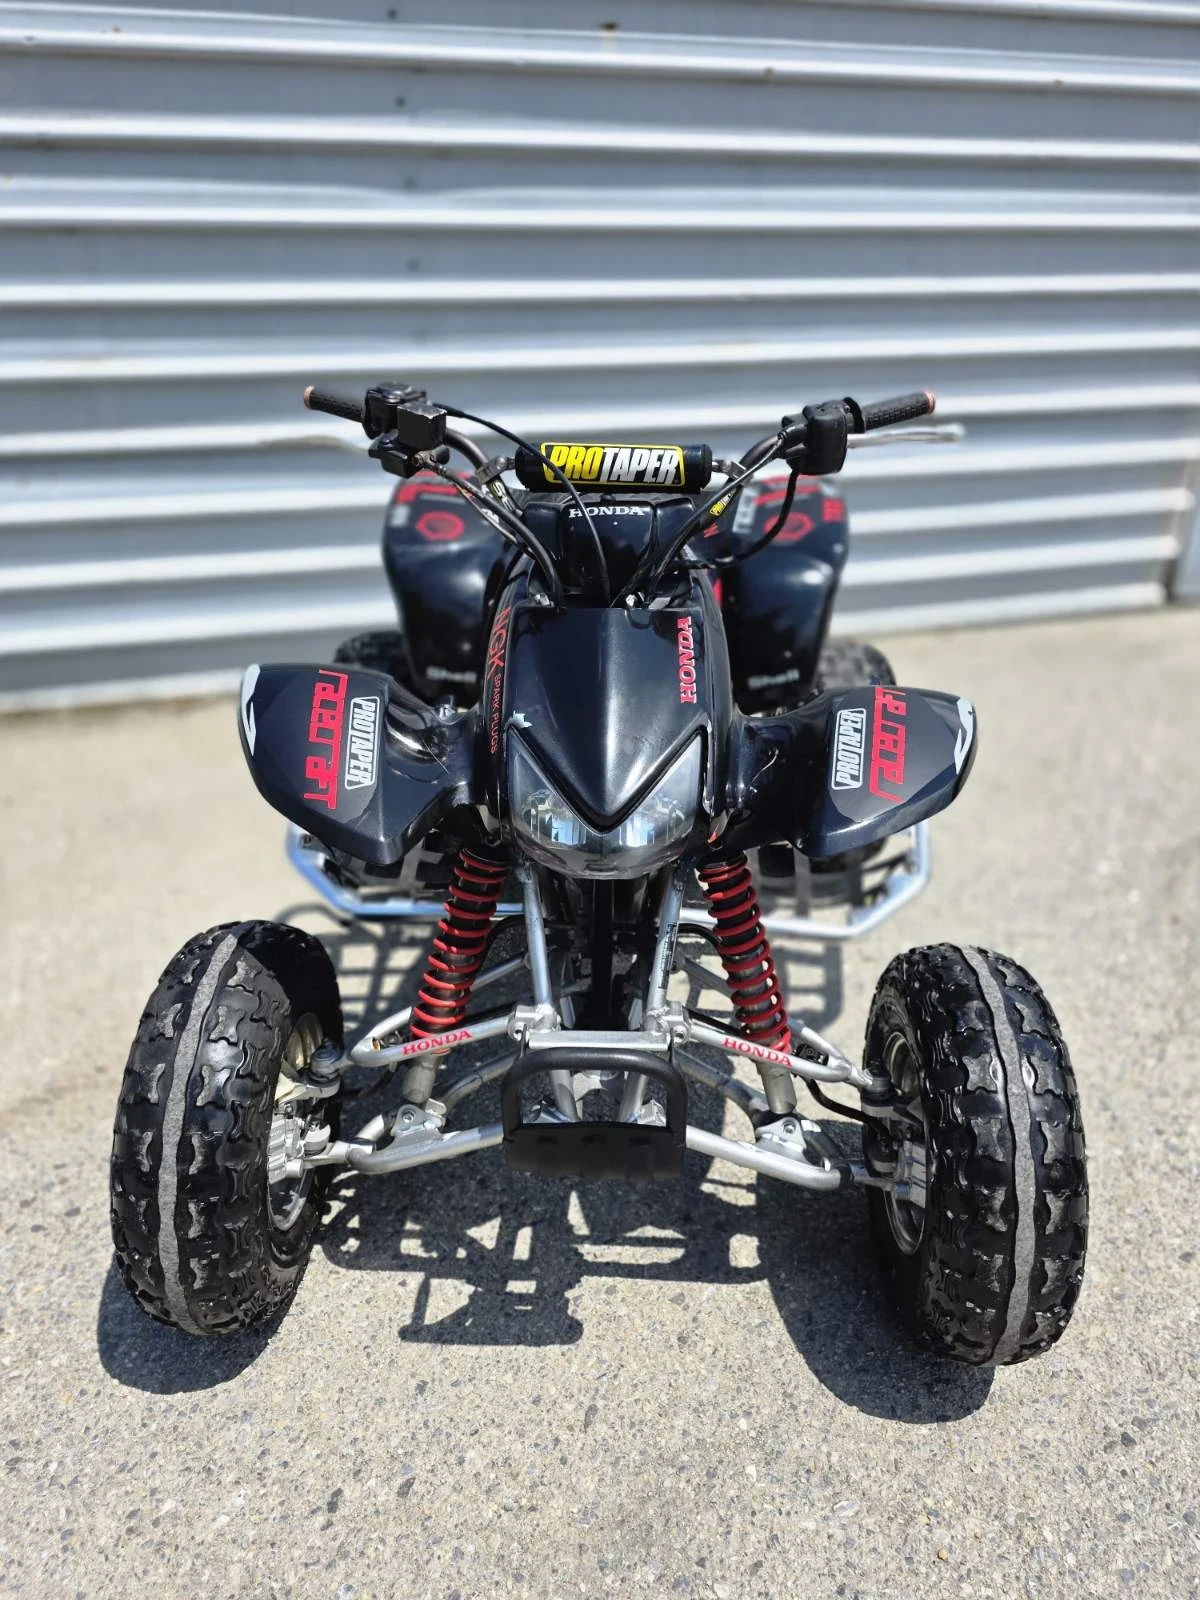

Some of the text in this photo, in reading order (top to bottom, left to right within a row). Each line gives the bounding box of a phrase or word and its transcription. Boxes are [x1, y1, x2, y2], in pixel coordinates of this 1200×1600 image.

[546, 445, 680, 485] PROTAPER
[568, 506, 646, 518] HONDA
[487, 607, 511, 754] NGK SPARK PLUGS
[677, 615, 697, 705] HONDA
[345, 698, 377, 786] PROTAPER
[835, 709, 865, 787] PROTAPER
[402, 1027, 474, 1056] HONDA
[723, 1036, 793, 1067] HONDA
